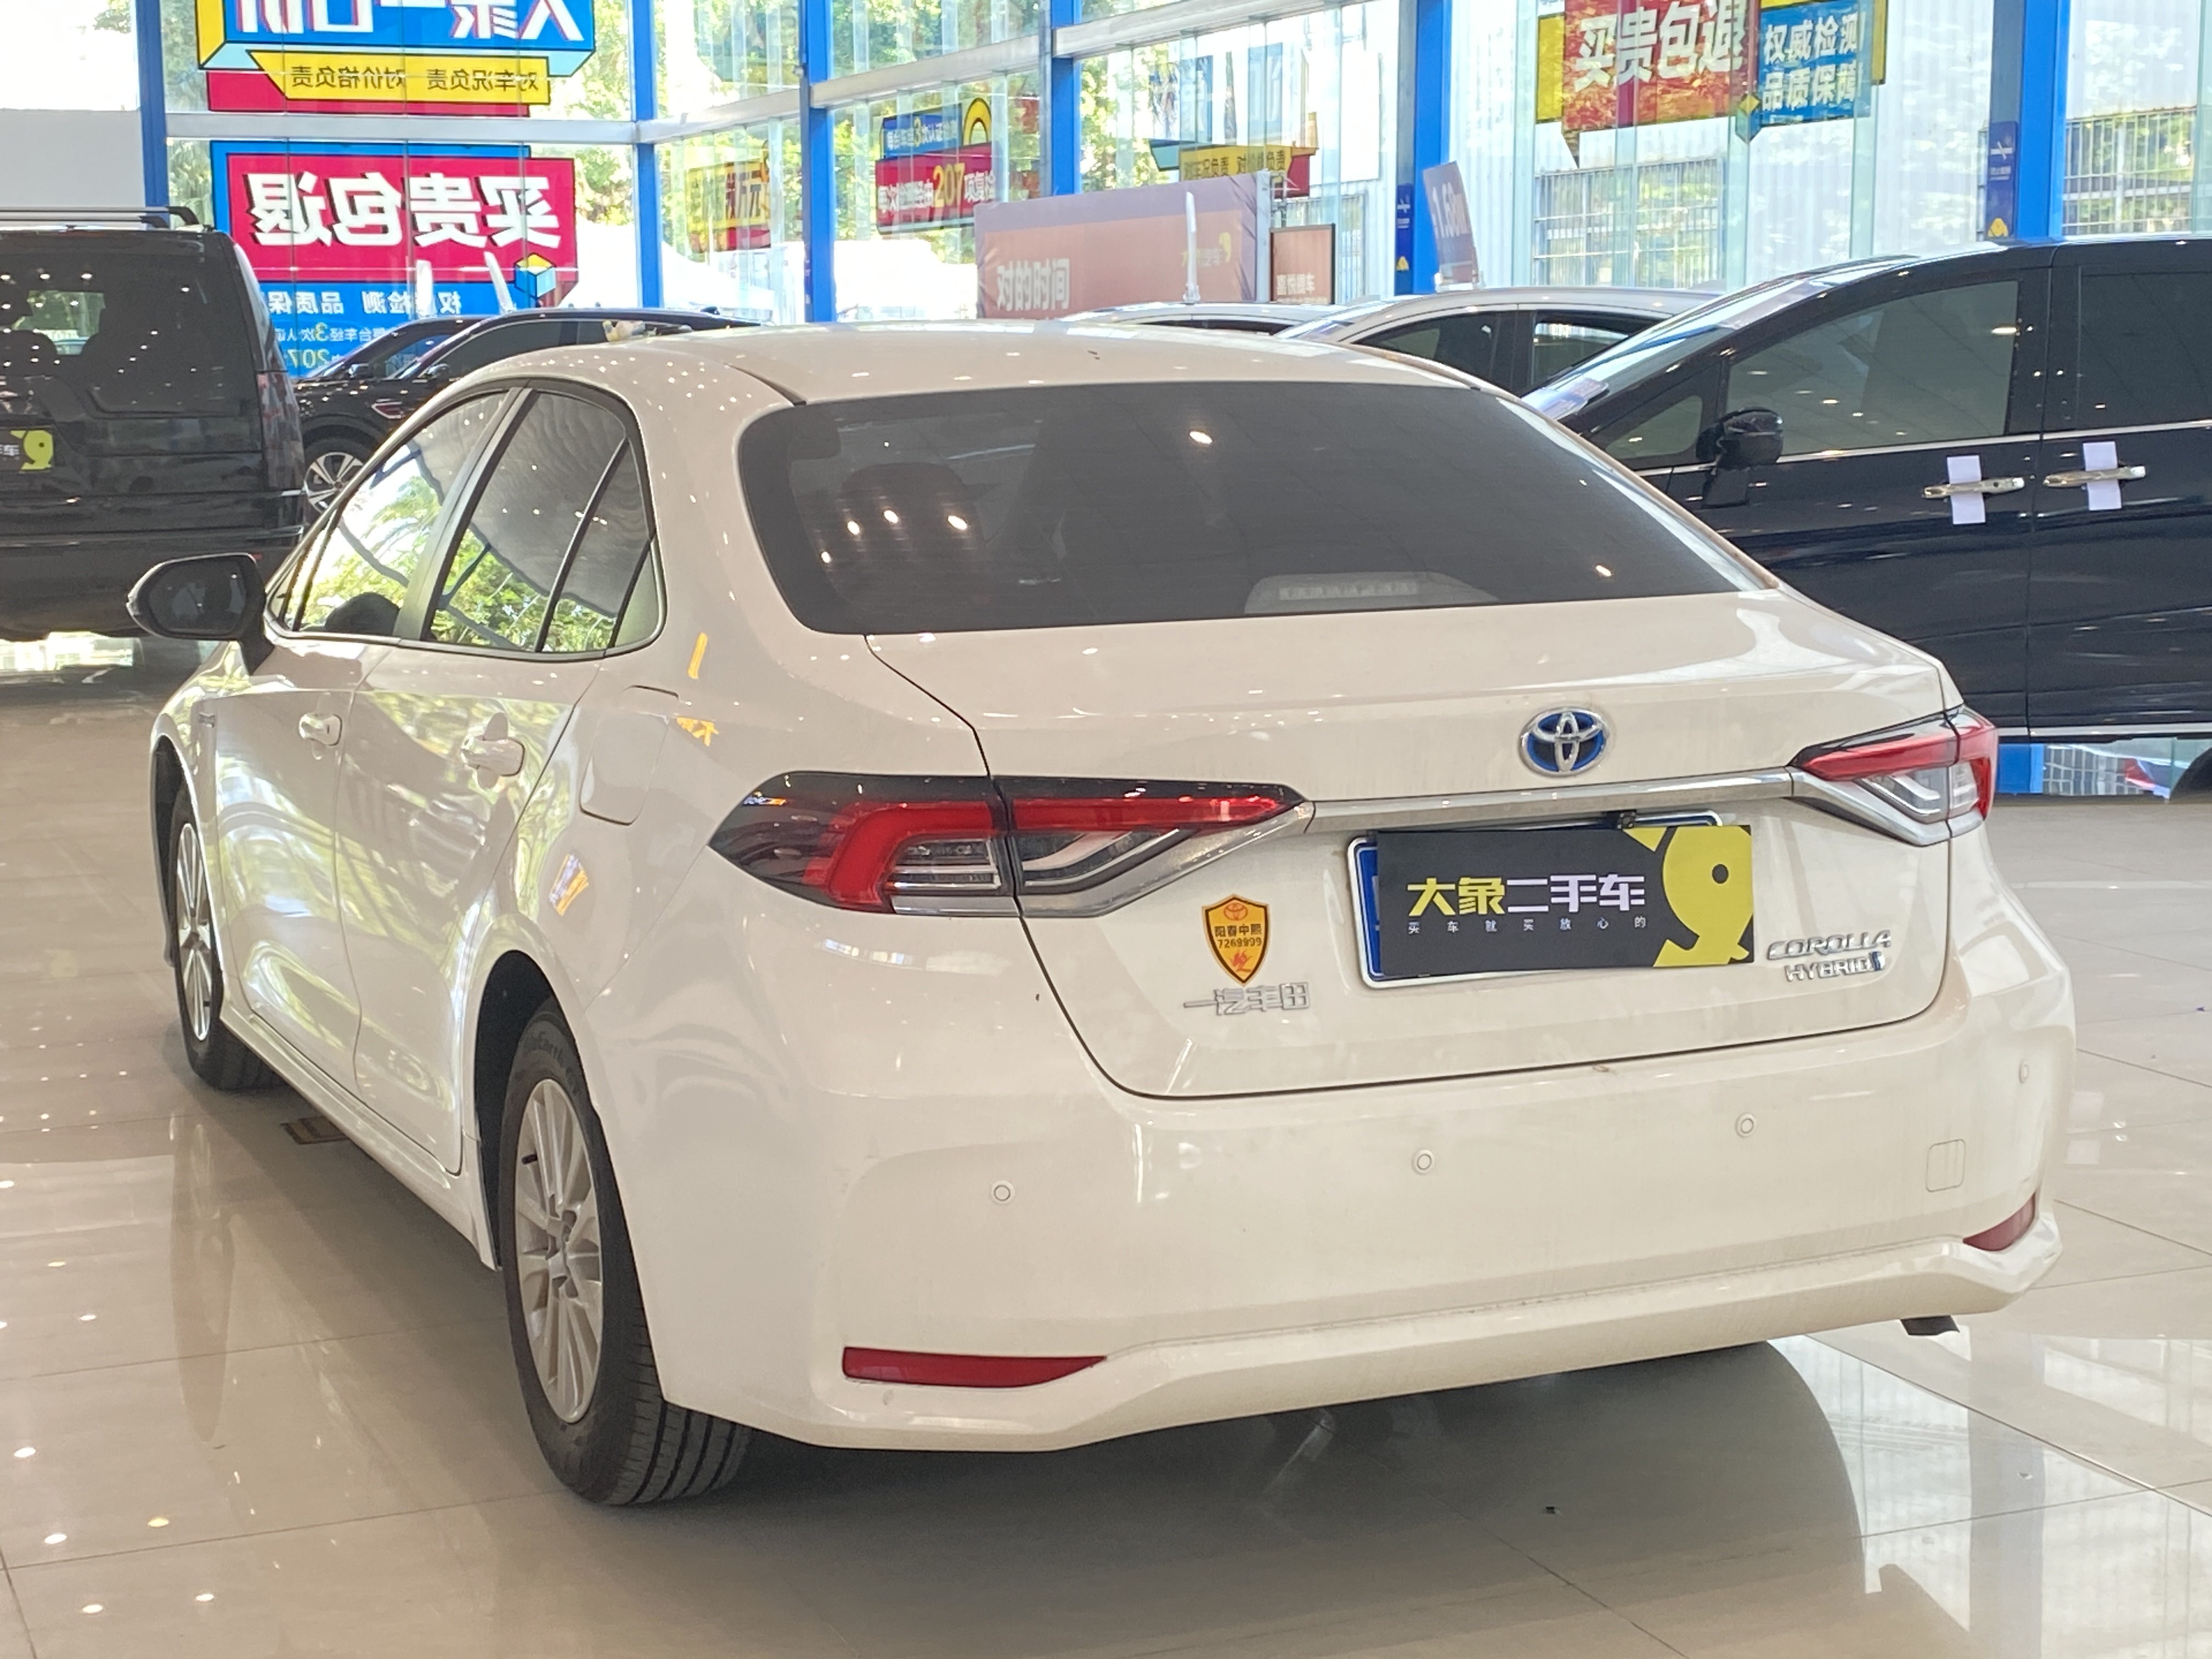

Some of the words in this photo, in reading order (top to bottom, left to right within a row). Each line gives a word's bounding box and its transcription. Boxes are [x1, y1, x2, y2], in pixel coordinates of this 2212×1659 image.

[1574, 0, 1746, 93] 买贵包退
[1764, 12, 1864, 65] 权威检测
[1762, 62, 1865, 111] 品质保障
[997, 258, 1070, 312] 对的时间
[1407, 874, 1645, 917] 大象二手车
[1767, 929, 1892, 961] COROLLA
[1785, 956, 1871, 982] HYBRID
[1183, 981, 1311, 1015] 一汽丰田
